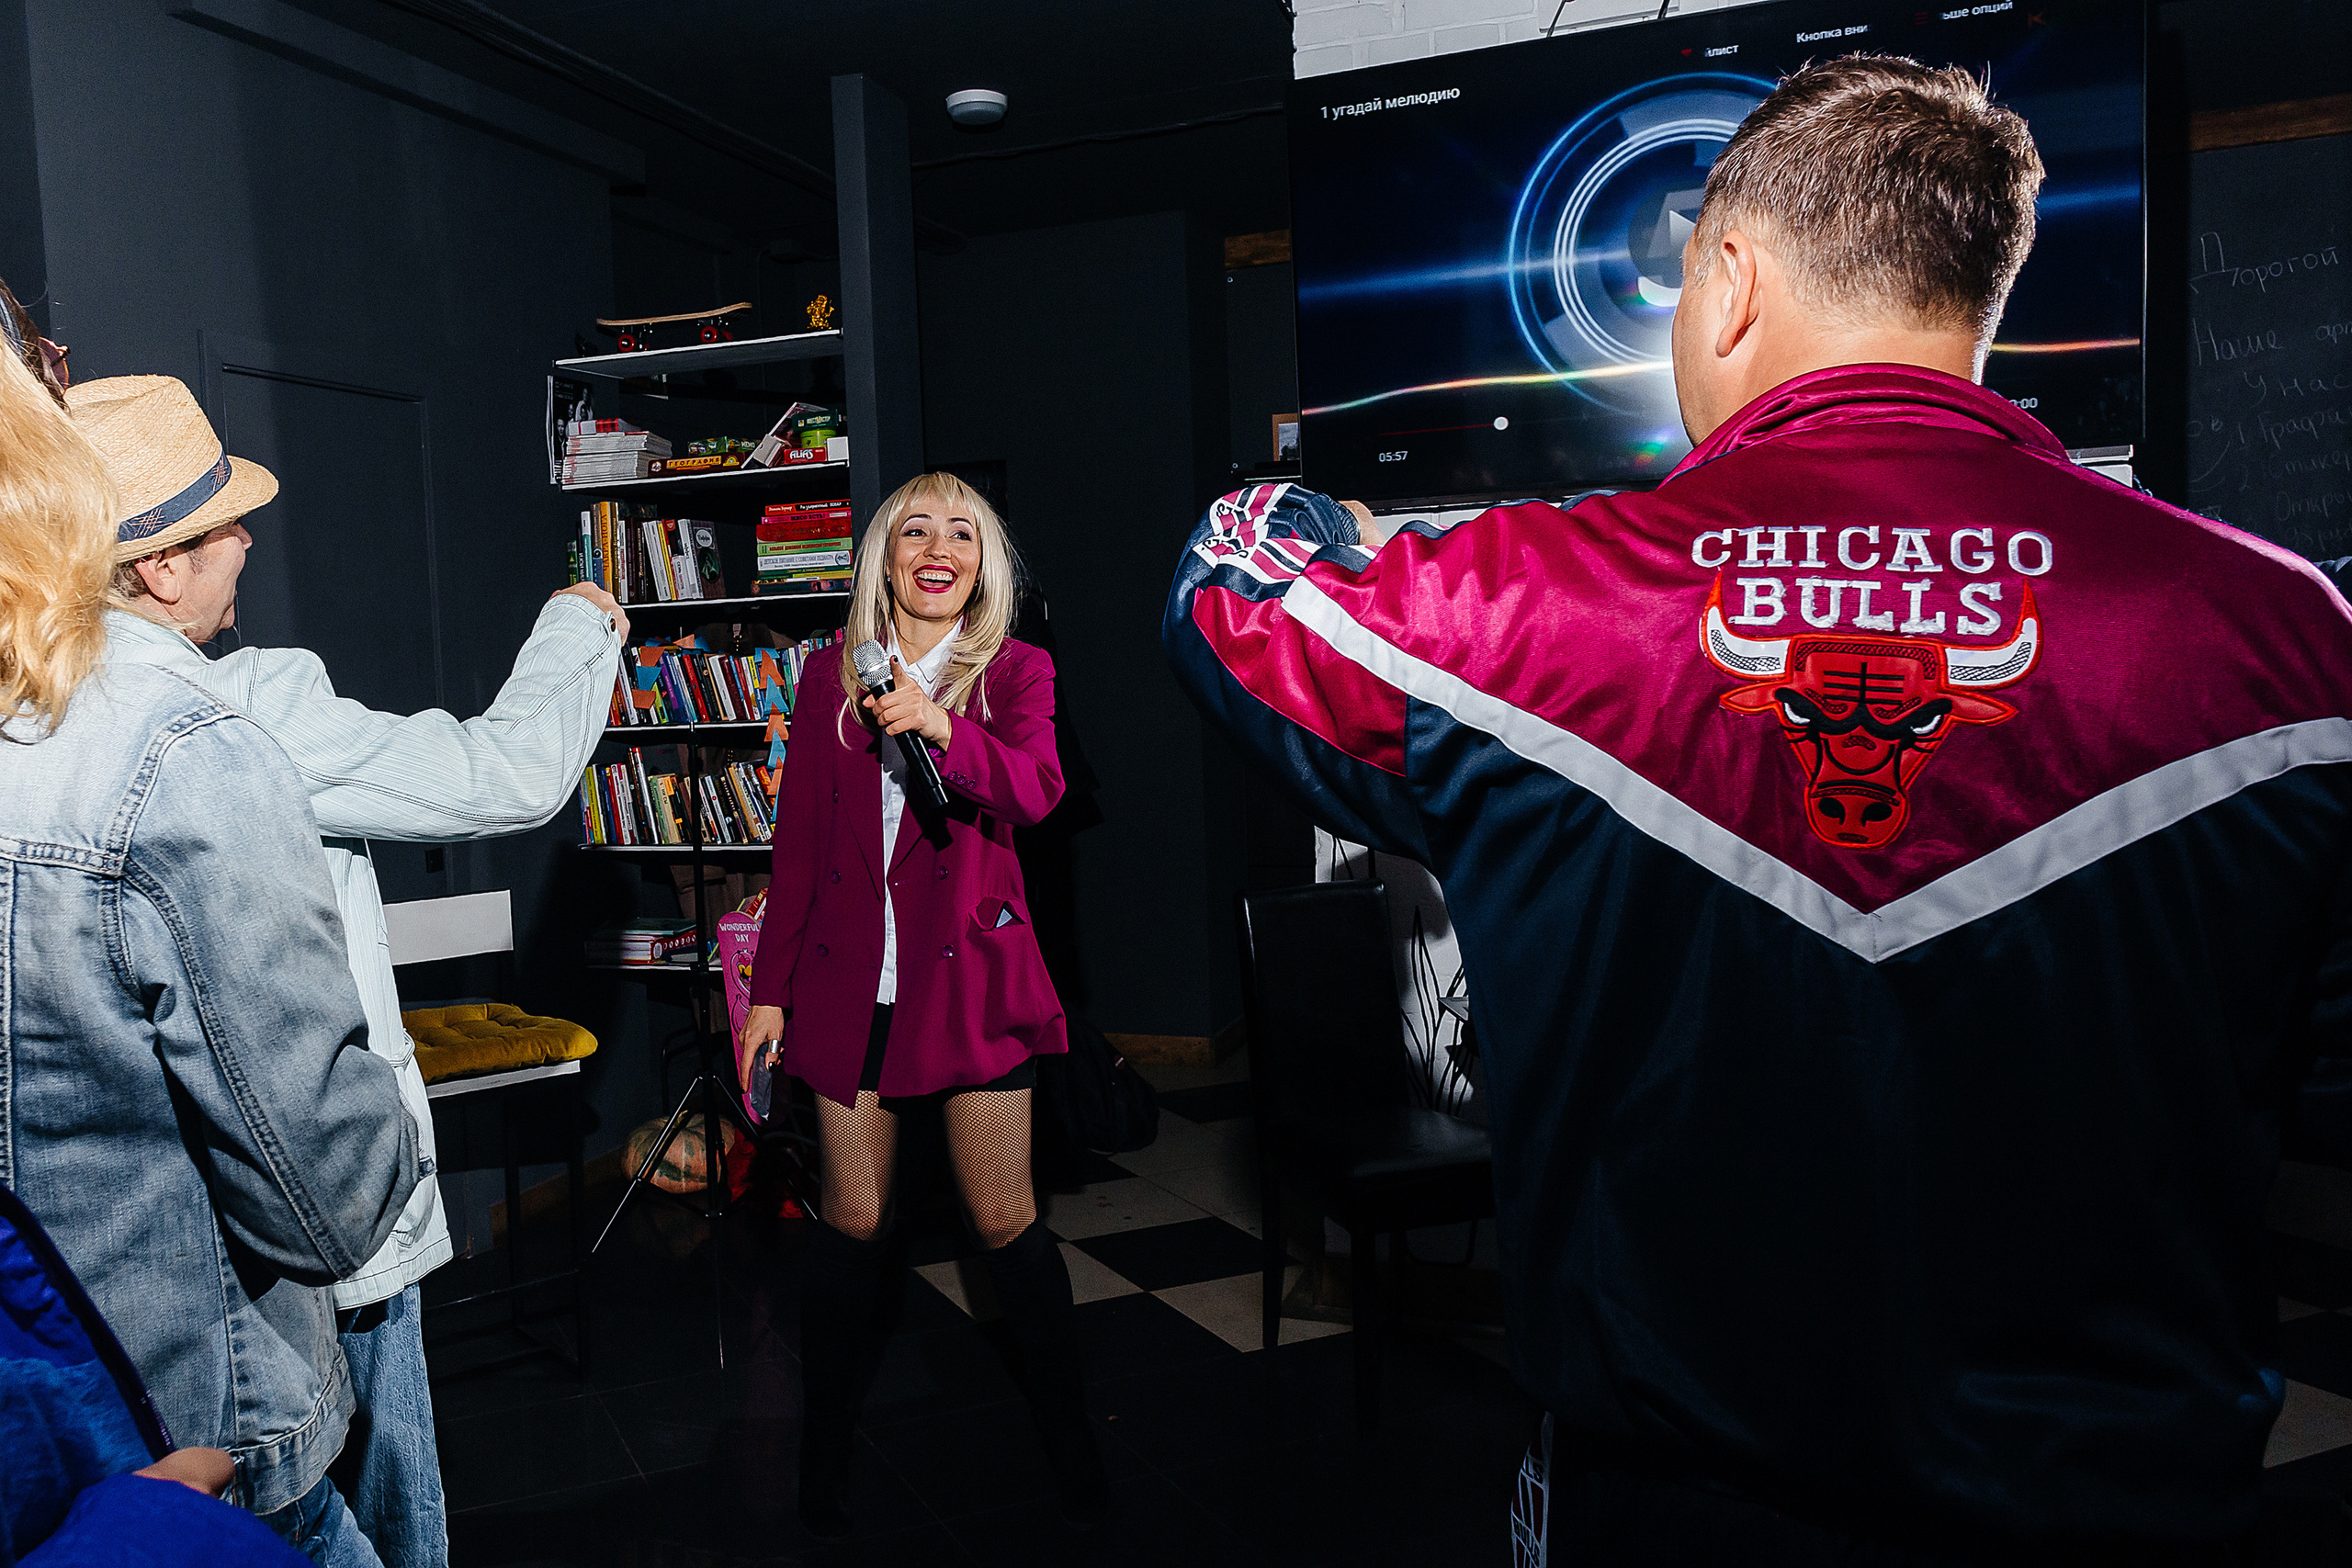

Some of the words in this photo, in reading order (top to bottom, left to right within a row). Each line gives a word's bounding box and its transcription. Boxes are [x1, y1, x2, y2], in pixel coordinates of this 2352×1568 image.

[1972, 0, 2013, 15] опций
[1796, 27, 1842, 43] Кнопка
[1320, 106, 1328, 118] 1
[1331, 96, 1382, 120] угадай
[1385, 87, 1461, 109] мелюдию
[2188, 231, 2339, 294] Дорогой
[2192, 317, 2284, 366] Наше
[2278, 373, 2352, 398] нас
[1378, 450, 1408, 463] 05:57
[1690, 525, 2053, 576] CHICAGO
[1728, 575, 2002, 637] BULLS
[718, 922, 761, 932] WONDERFUL
[735, 933, 750, 943] DAY
